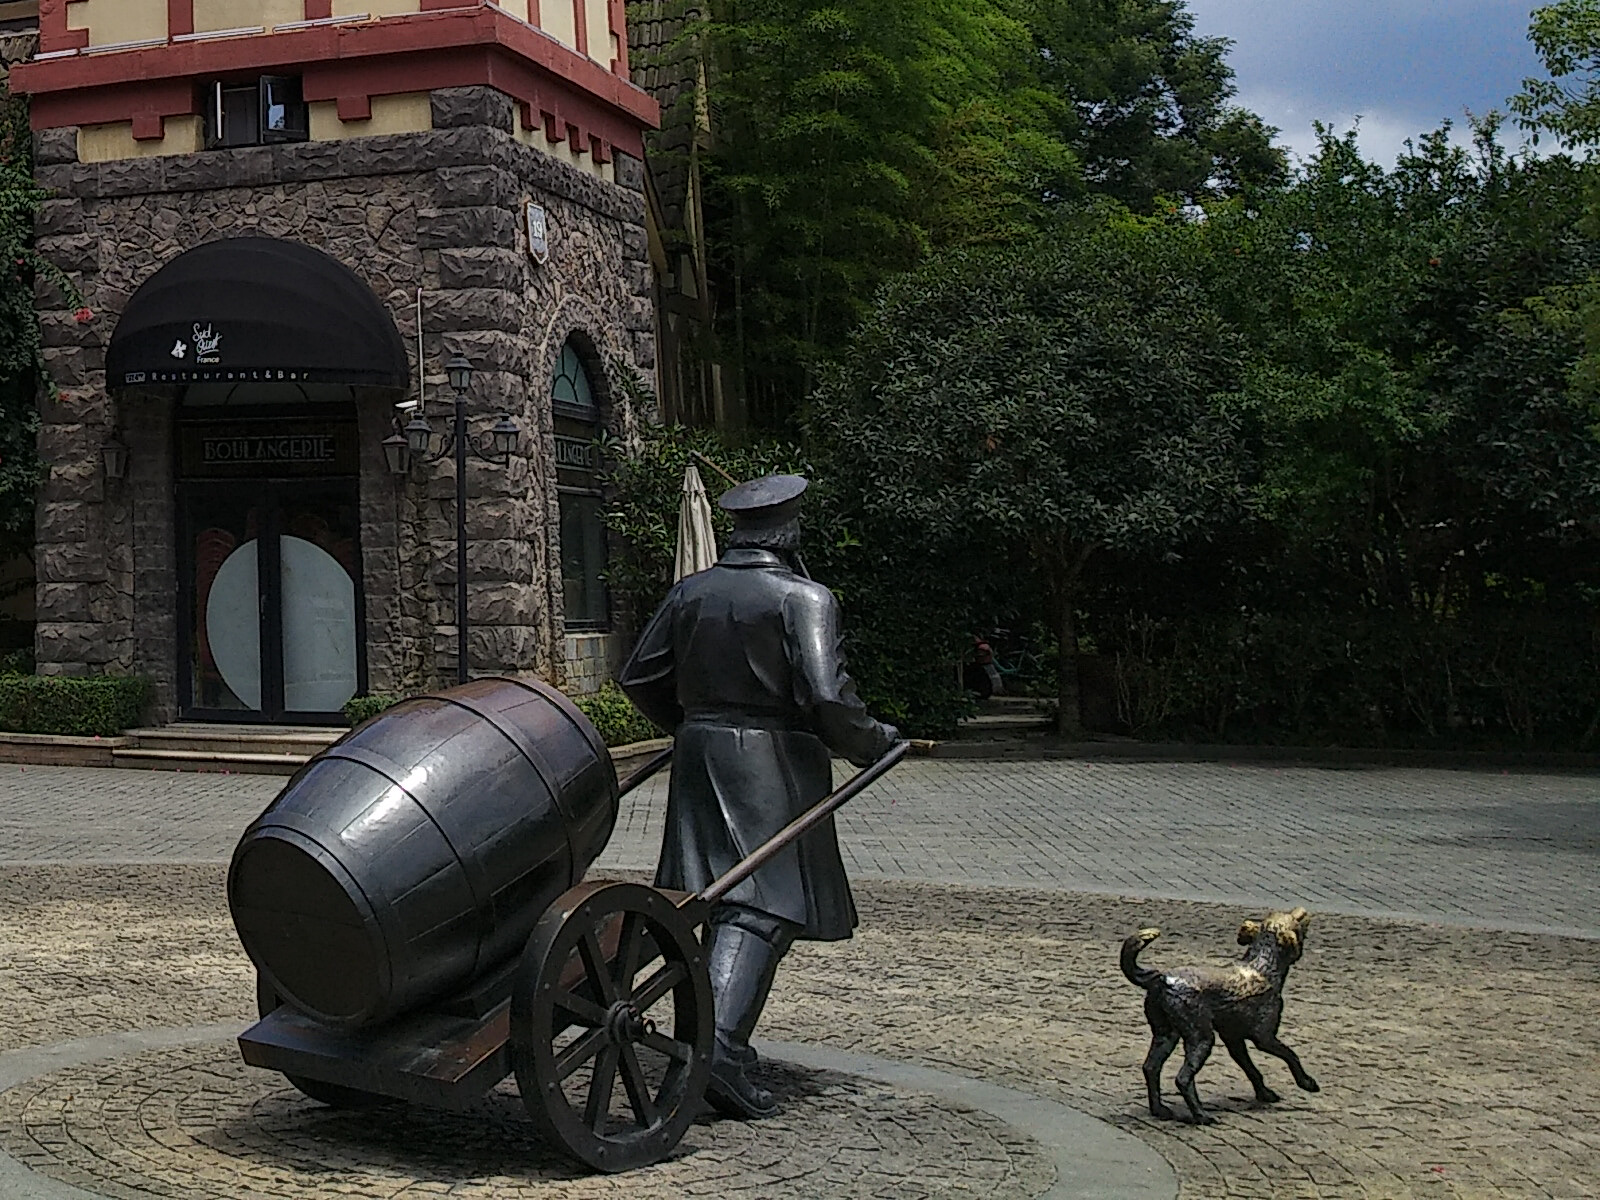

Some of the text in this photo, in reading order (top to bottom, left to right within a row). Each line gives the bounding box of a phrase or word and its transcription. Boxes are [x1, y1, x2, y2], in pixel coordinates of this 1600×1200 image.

[532, 220, 543, 238] 19
[192, 322, 212, 342] Sud
[196, 355, 221, 364] France
[204, 437, 336, 460] BOULANGERIE
